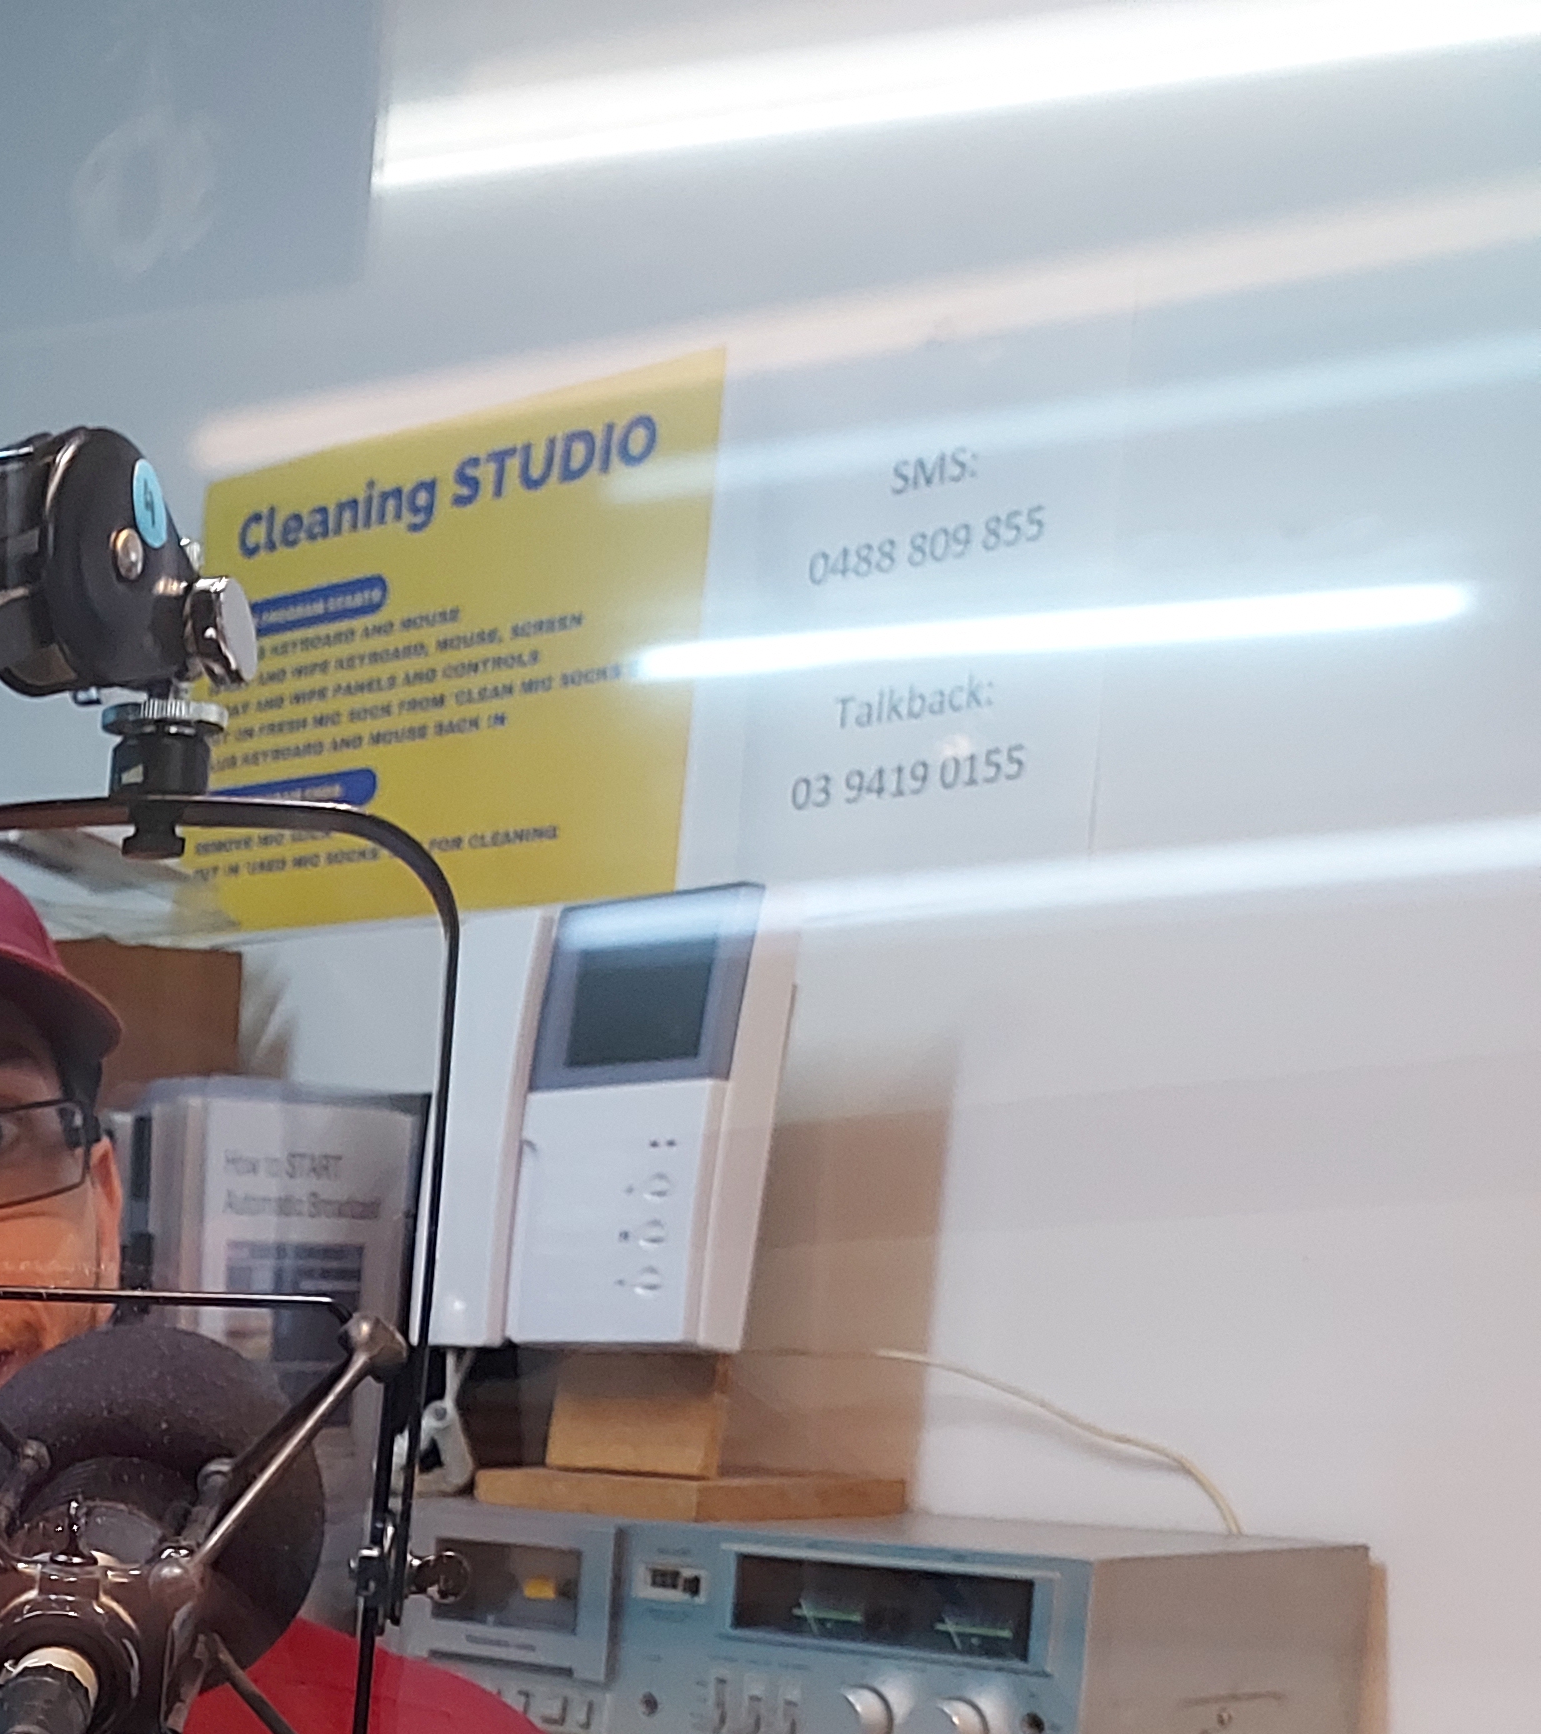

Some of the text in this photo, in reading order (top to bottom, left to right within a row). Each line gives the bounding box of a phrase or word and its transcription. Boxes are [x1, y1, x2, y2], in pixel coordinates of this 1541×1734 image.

[238, 414, 658, 559] Cleaning STUDIO
[891, 446, 979, 495] SMS:
[808, 504, 1046, 586] 0488 809 855
[362, 620, 395, 640] AND
[835, 670, 995, 730] Talkback:
[790, 743, 1026, 812] 03 9419 0155
